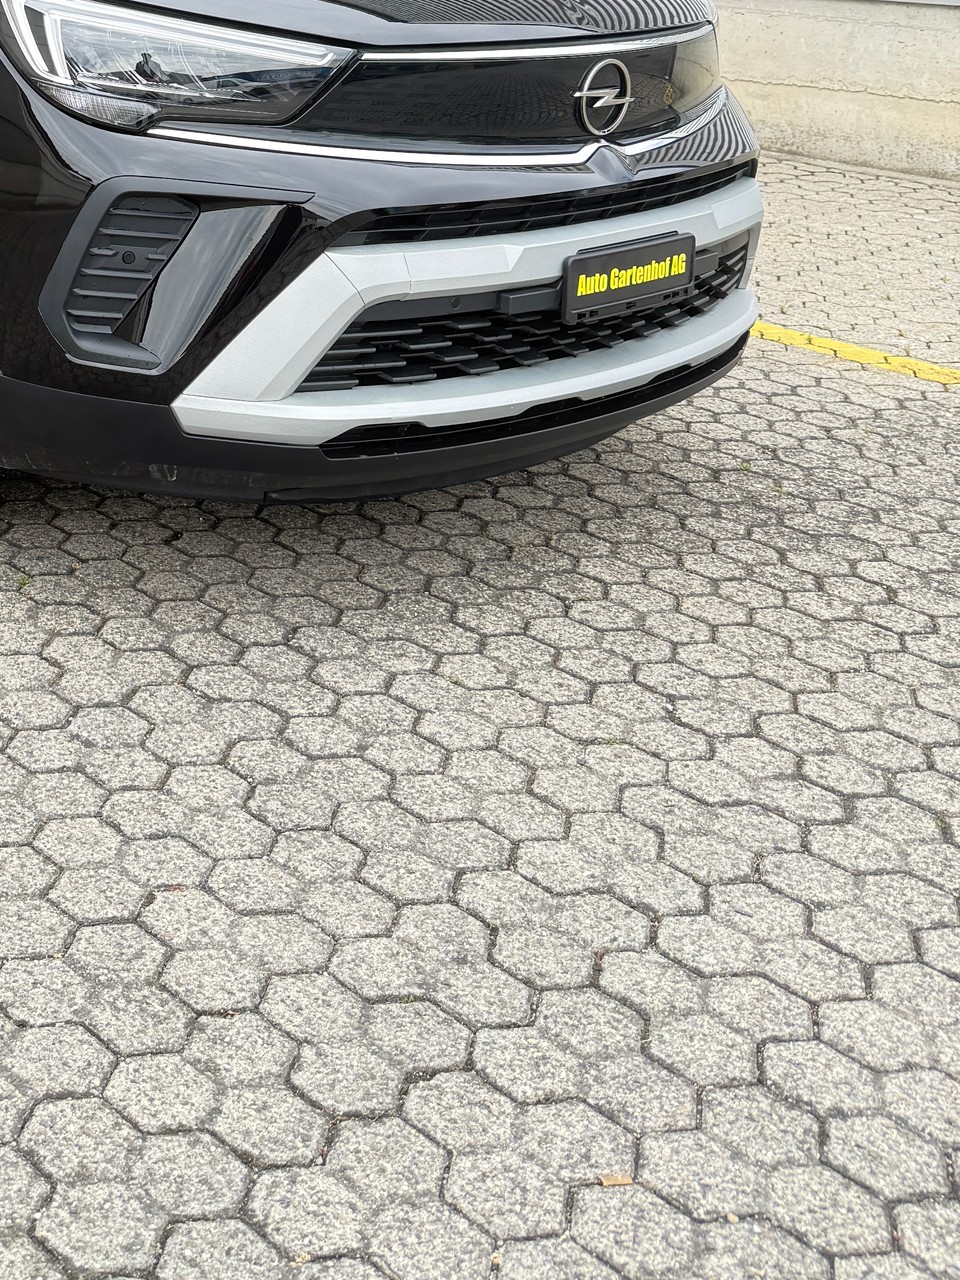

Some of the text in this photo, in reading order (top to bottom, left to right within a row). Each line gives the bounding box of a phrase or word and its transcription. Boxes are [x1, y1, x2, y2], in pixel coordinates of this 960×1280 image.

[576, 253, 687, 297] Auto Gartenhof AG
